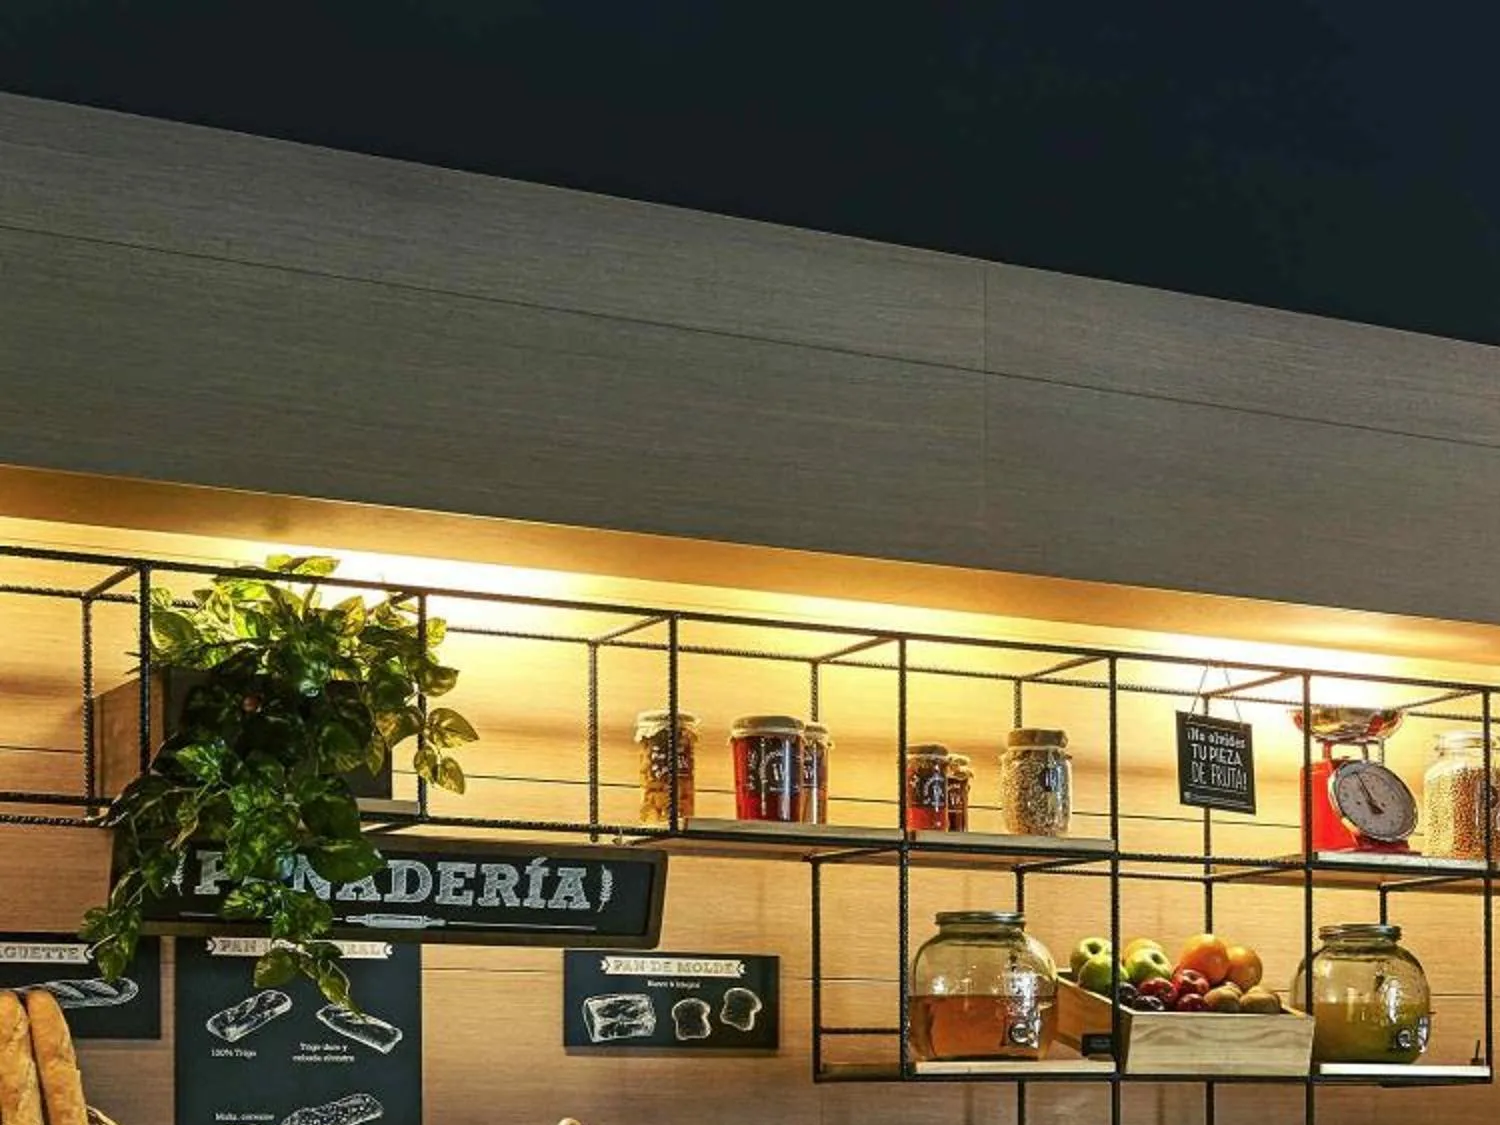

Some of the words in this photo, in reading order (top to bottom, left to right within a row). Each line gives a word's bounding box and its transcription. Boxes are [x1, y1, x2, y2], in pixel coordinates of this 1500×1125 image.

[1191, 743, 1207, 760] TU
[1210, 746, 1243, 766] PIEZA
[1191, 761, 1207, 785] DE
[193, 850, 591, 910] PNADERÍA
[0, 945, 79, 960] GUETTE
[613, 959, 644, 972] PAN
[650, 960, 670, 972] DE
[677, 961, 735, 974] MOLDE
